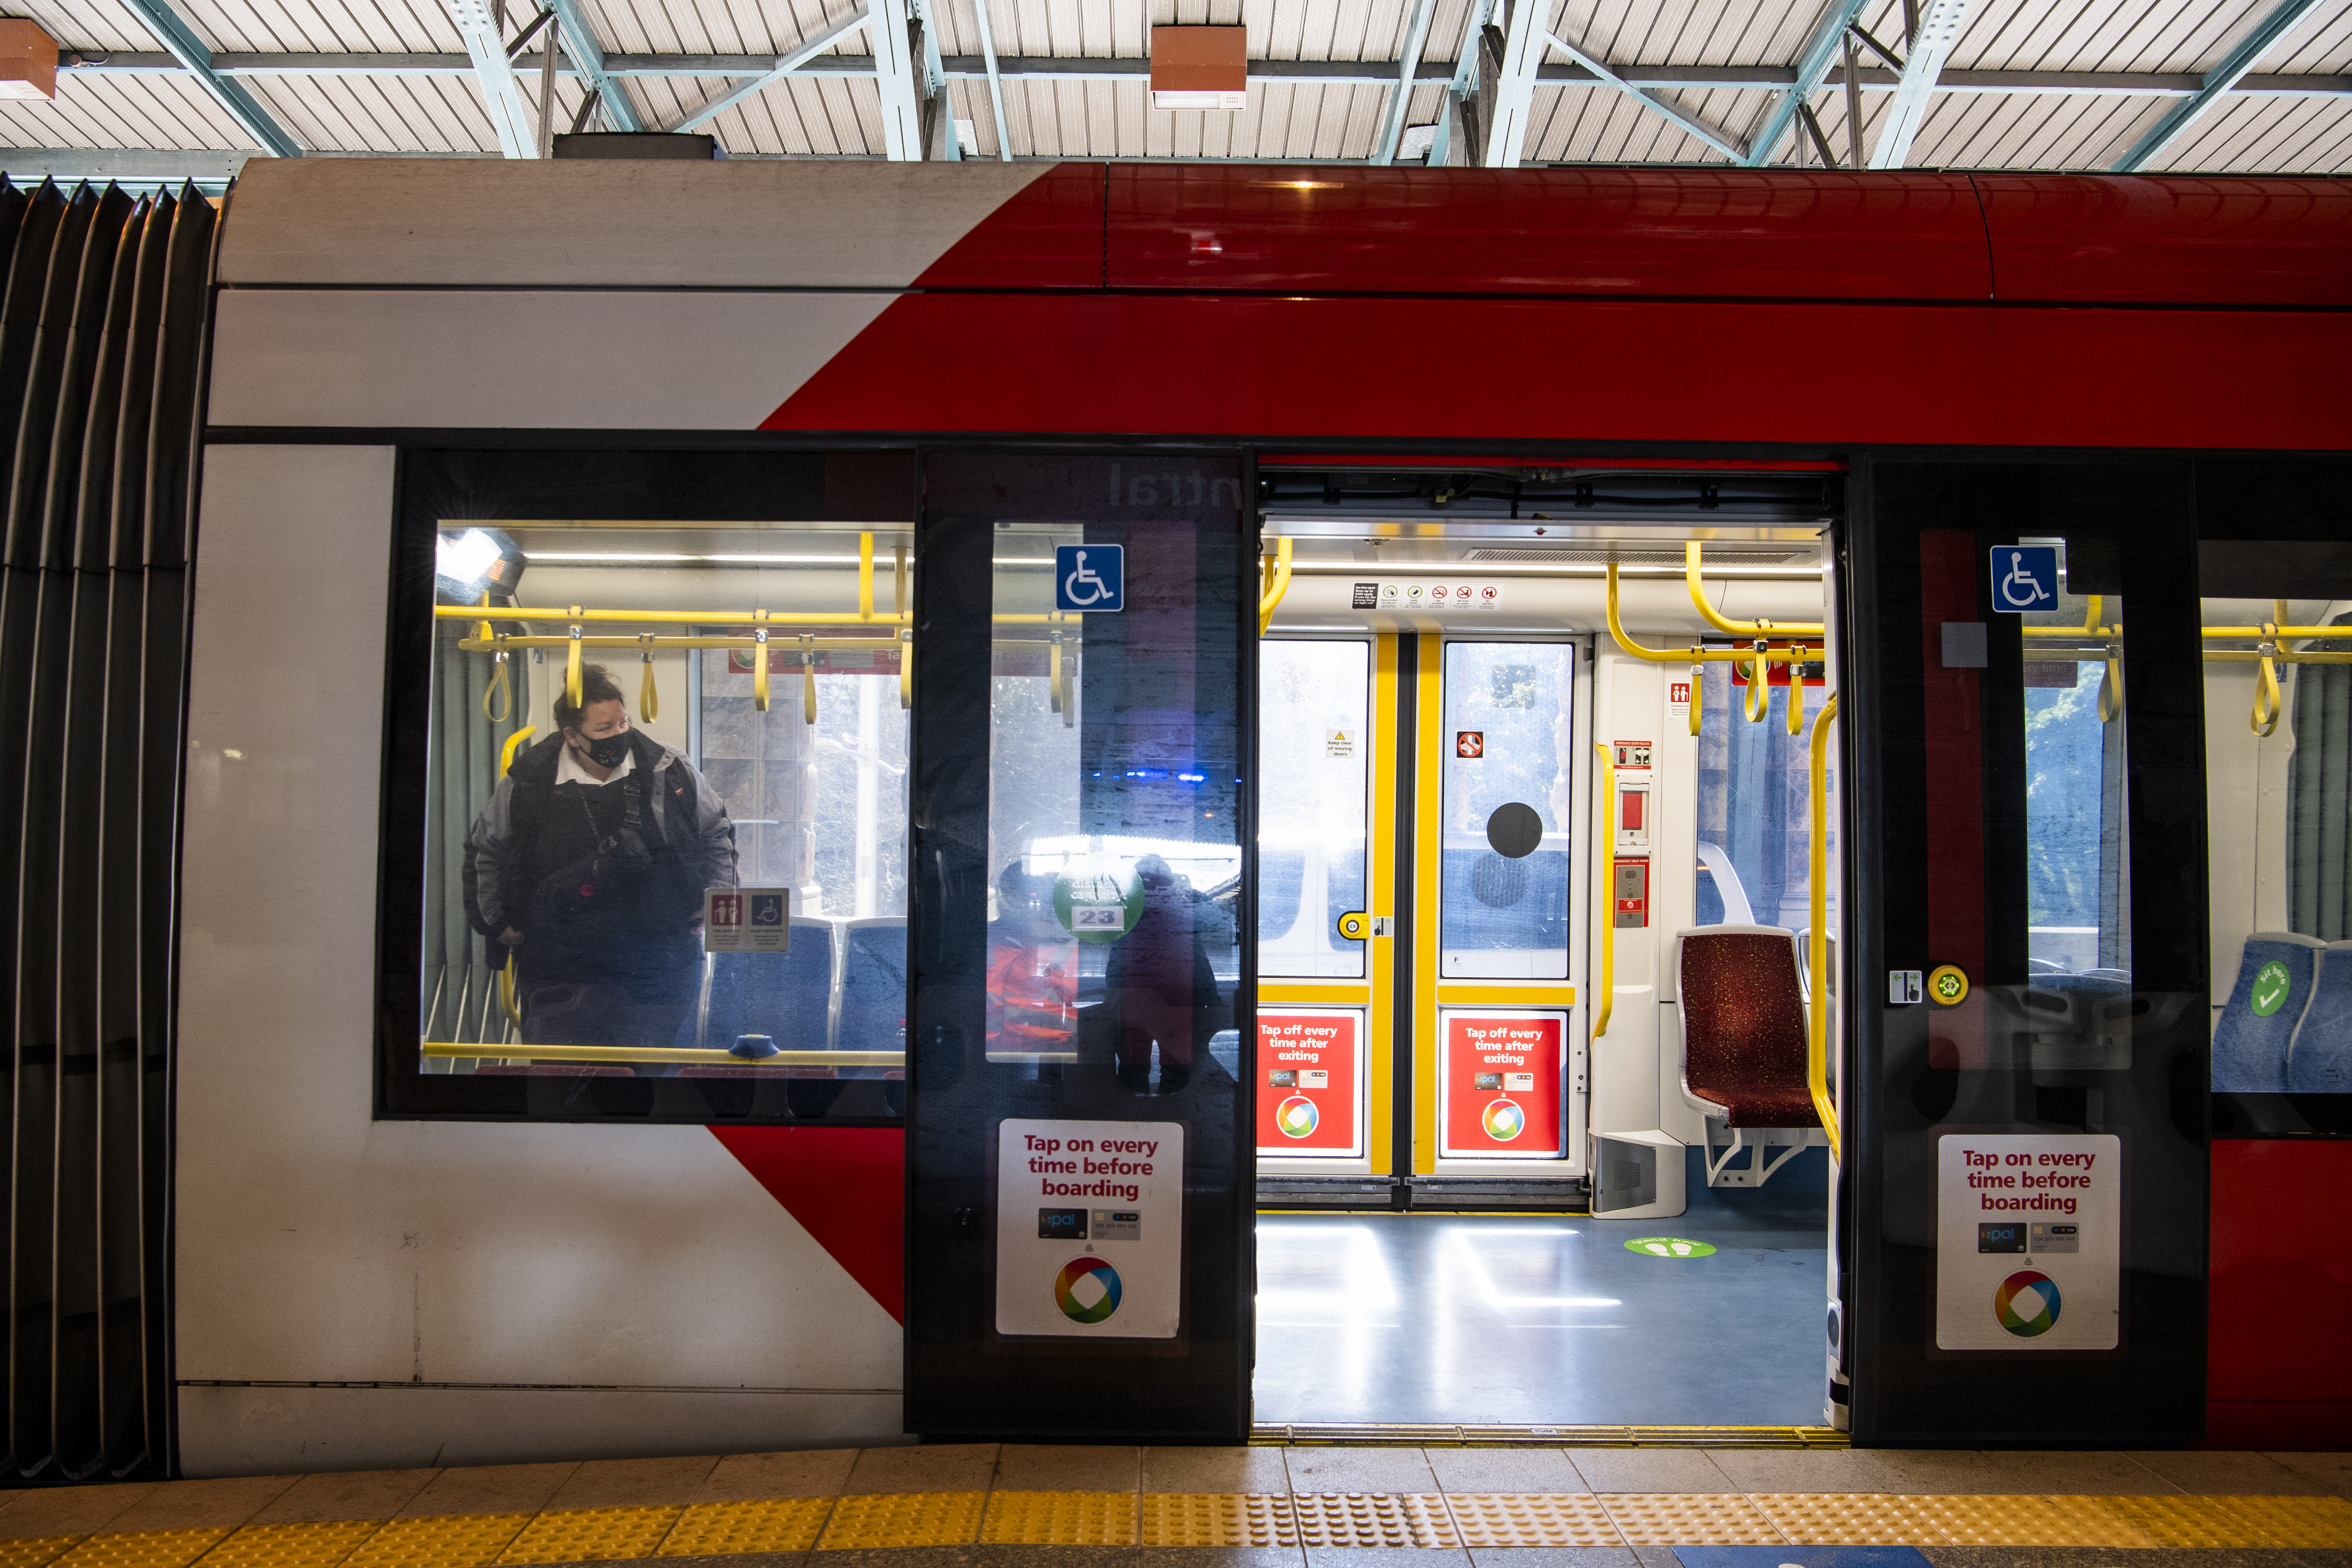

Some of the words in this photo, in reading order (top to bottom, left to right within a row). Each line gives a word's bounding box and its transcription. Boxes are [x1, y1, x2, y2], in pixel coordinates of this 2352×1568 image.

[886, 650, 902, 660] Ta
[1080, 910, 1115, 925] 23
[2273, 965, 2286, 985] here
[1260, 1024, 1281, 1037] Tap
[1284, 1024, 1302, 1035] off
[1304, 1027, 1338, 1038] every
[1466, 1028, 1486, 1040] Tap
[1489, 1028, 1508, 1038] off
[1510, 1030, 1543, 1040] every
[1269, 1037, 1297, 1048] time
[1299, 1037, 1329, 1048] after
[1475, 1040, 1502, 1050] time
[1505, 1040, 1534, 1051] after
[1278, 1050, 1319, 1063] exiting
[1484, 1053, 1524, 1066] exiting
[1024, 1135, 1061, 1155] Tap
[1067, 1138, 1094, 1152] on
[1100, 1140, 1159, 1158] every
[1028, 1157, 1077, 1173] time
[1083, 1157, 1153, 1175] before
[1963, 1150, 1999, 1170] Tap
[2005, 1153, 2032, 1166] on
[2038, 1153, 2096, 1171] every
[1967, 1171, 2016, 1188] time
[2021, 1171, 2091, 1188] before
[1042, 1178, 1139, 1201] boarding
[1981, 1193, 2077, 1214] boarding
